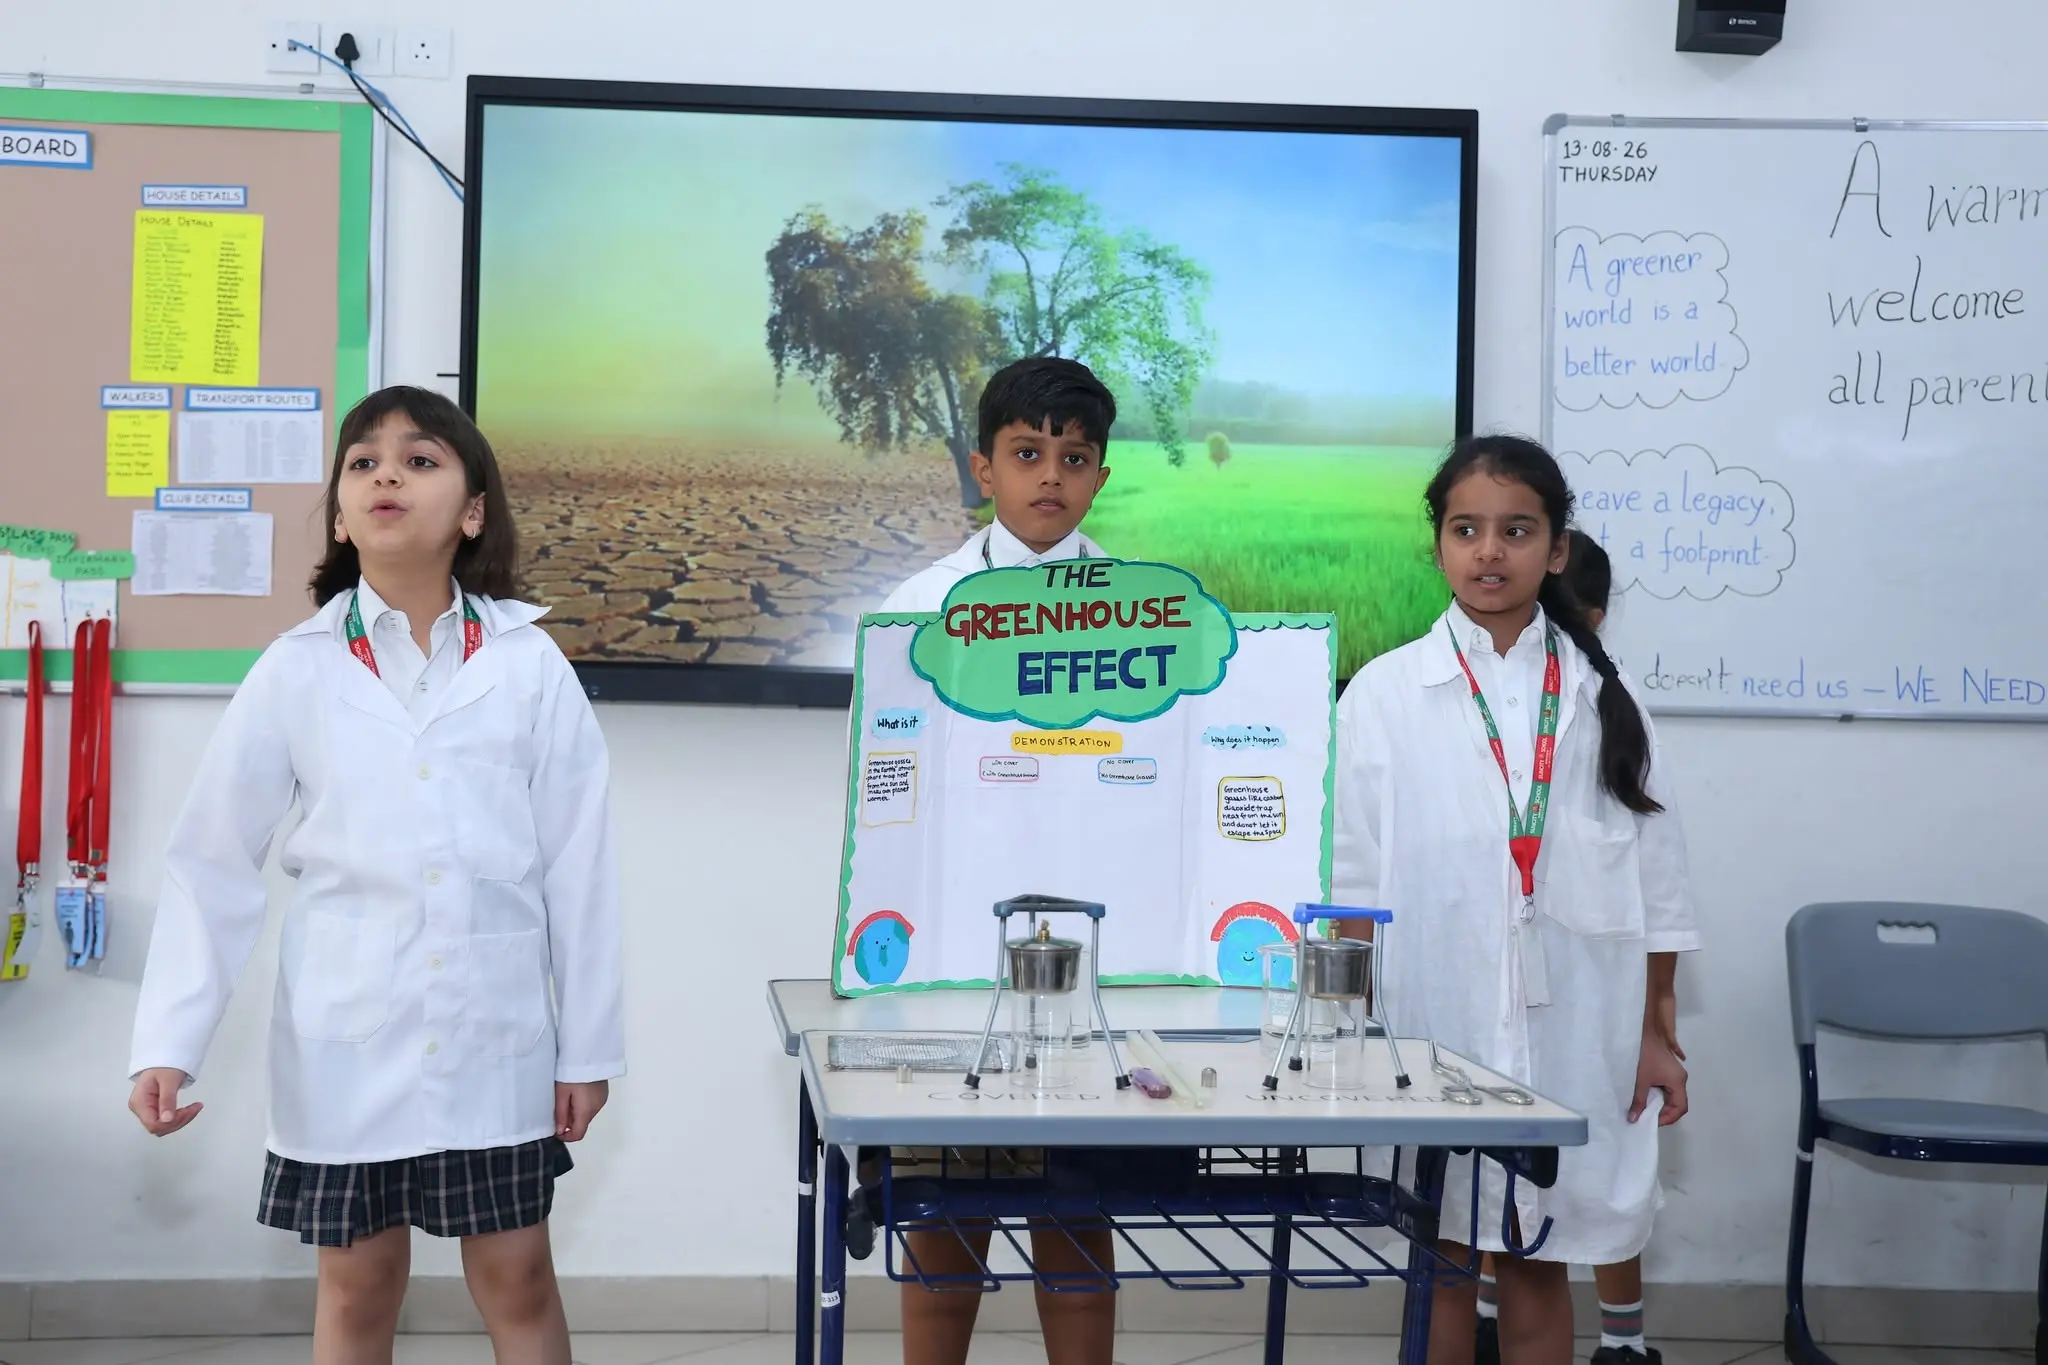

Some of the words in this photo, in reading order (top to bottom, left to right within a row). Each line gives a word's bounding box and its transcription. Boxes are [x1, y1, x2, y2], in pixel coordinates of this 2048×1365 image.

[2, 136, 77, 158] BOARD
[1559, 165, 1657, 182] THURSDAY
[147, 190, 187, 200] HOUSE
[191, 191, 240, 201] DETAILS
[1830, 140, 1893, 238] A
[1568, 244, 1593, 292] A
[1605, 251, 1702, 297] greener
[1828, 255, 2024, 327] welcome
[1565, 298, 1631, 328] world
[1654, 303, 1670, 321] is
[1685, 301, 1698, 319] a
[1565, 345, 1637, 377] better
[1828, 350, 1885, 405] all
[110, 391, 164, 402] WALKERS
[196, 393, 262, 404] TRANSPORT
[265, 395, 311, 406] ROUTES
[163, 493, 191, 504] CLUB
[195, 494, 246, 504] DETAILS
[1575, 491, 1642, 512] eave
[1654, 492, 1671, 513] a
[1630, 541, 1644, 558] a
[1042, 562, 1114, 589] THE
[945, 595, 1191, 646] GREENHOUSE
[1018, 645, 1177, 696] EFFECT
[1743, 656, 1805, 698] need
[1816, 679, 1849, 698] us
[1896, 665, 1941, 703] WE
[1963, 667, 2046, 705] NEED
[877, 718, 899, 729] What
[901, 717, 908, 729] is
[910, 716, 919, 728] it
[1014, 737, 1112, 748] DEMONSTRATION
[1210, 736, 1224, 745] Why
[1252, 736, 1280, 745] happen
[1224, 785, 1269, 793] Greenhouse
[1256, 805, 1273, 813] trap
